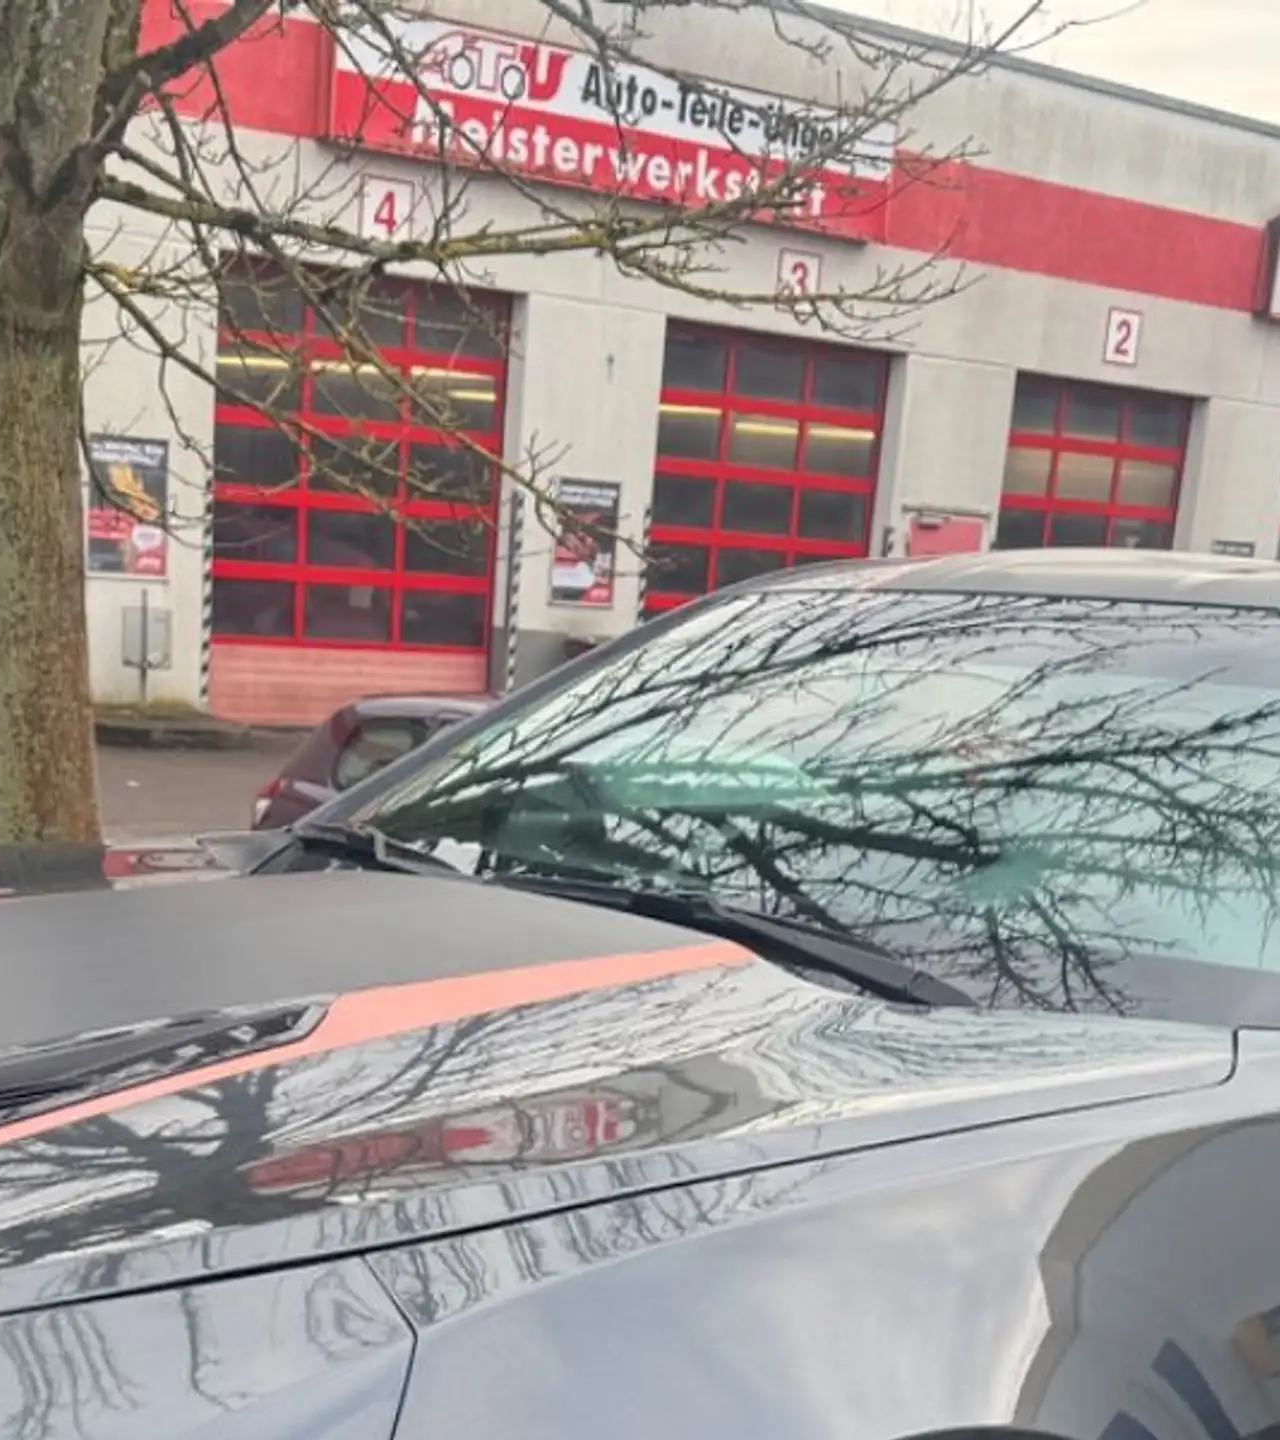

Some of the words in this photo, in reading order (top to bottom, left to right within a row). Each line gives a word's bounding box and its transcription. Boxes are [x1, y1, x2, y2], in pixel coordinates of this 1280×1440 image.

[374, 190, 397, 235] 4
[791, 261, 809, 301] 3
[1114, 318, 1132, 356] 2
